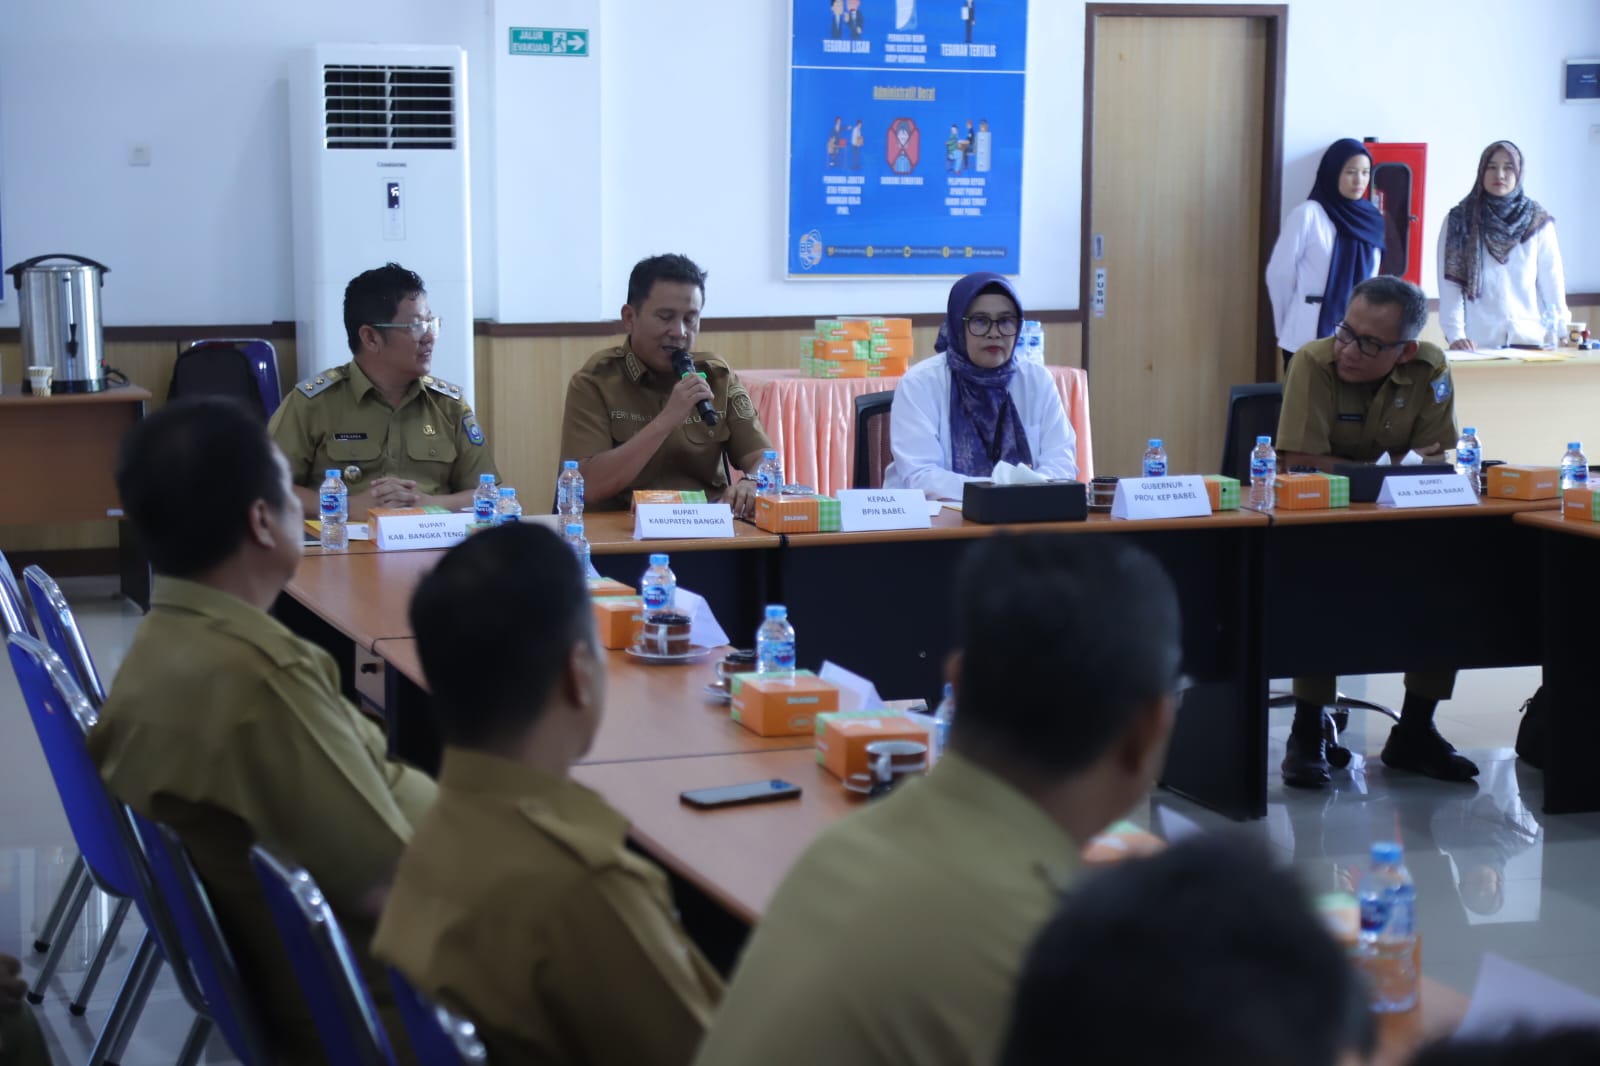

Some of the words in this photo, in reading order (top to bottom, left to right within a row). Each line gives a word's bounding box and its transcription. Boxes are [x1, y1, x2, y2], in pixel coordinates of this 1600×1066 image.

[519, 31, 544, 40] JALUR
[512, 43, 550, 52] EVAKUASI
[1141, 481, 1183, 490] GUBERNUR
[867, 495, 896, 503] KEPALA
[1172, 492, 1198, 500] BABEL
[881, 507, 907, 515] BABEL
[408, 532, 441, 540] BANGKA
